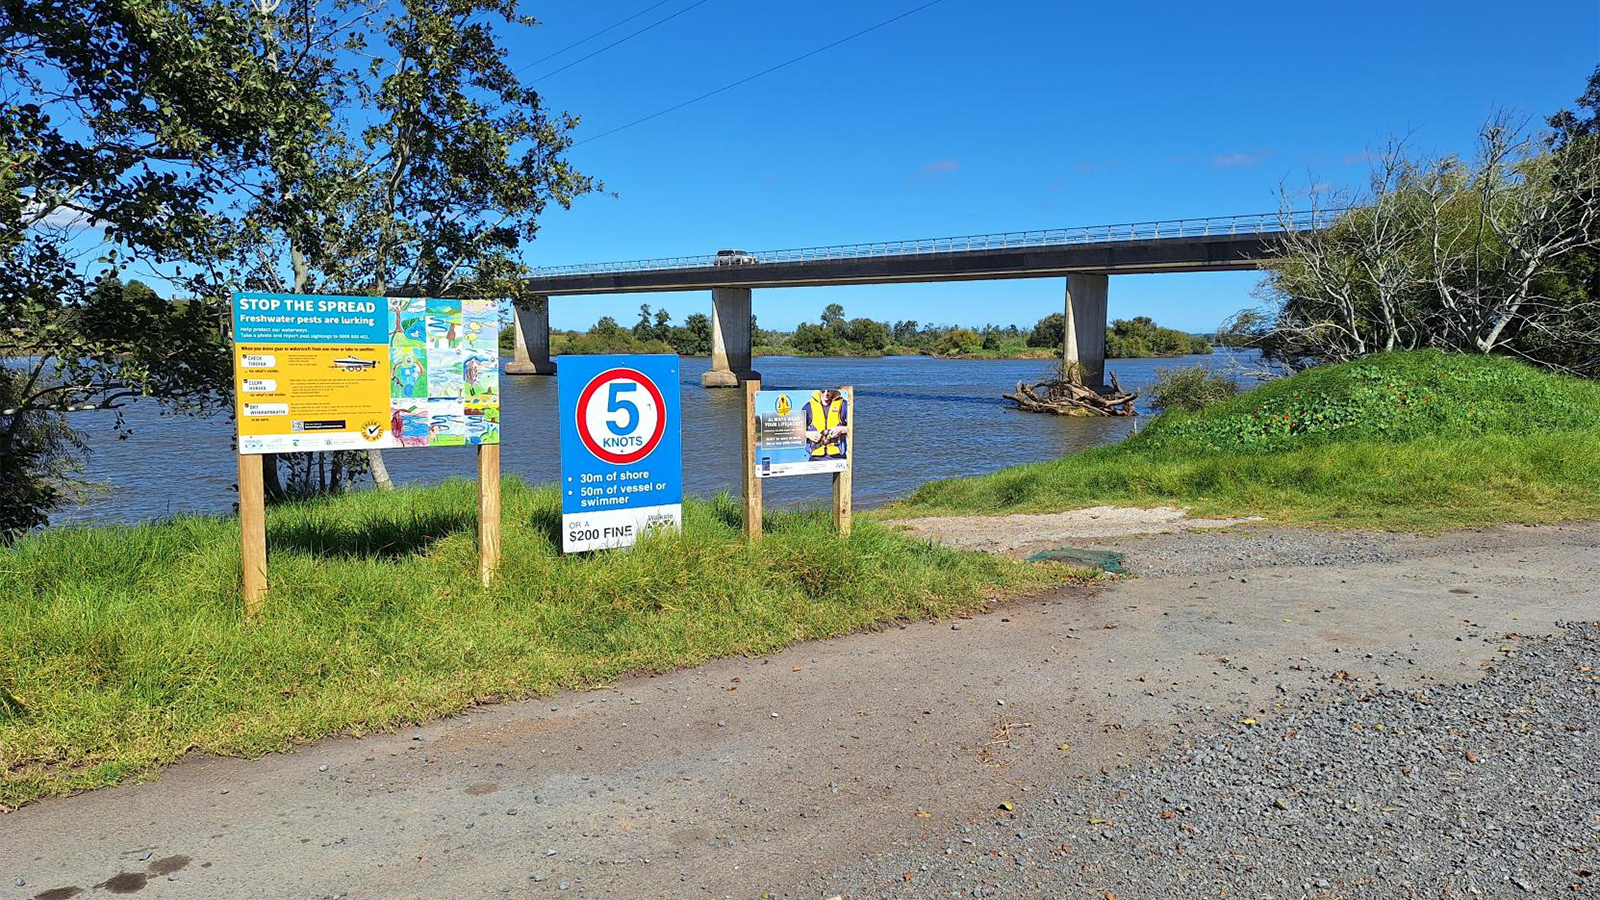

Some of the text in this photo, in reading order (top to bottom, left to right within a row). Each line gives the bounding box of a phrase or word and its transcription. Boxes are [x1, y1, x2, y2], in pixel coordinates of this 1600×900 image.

[239, 298, 376, 313] STOP THE SPREAD
[240, 314, 295, 324] Freshwater
[297, 315, 322, 325] pests
[341, 316, 375, 327] lurking
[606, 383, 639, 436] 5
[603, 436, 643, 447] KNOTS
[580, 470, 649, 483] 30m of shore
[581, 482, 667, 496] 50m of vessel or
[581, 496, 629, 507] swimmer
[648, 513, 673, 521] Waikato
[569, 525, 633, 542] $200 FINE
